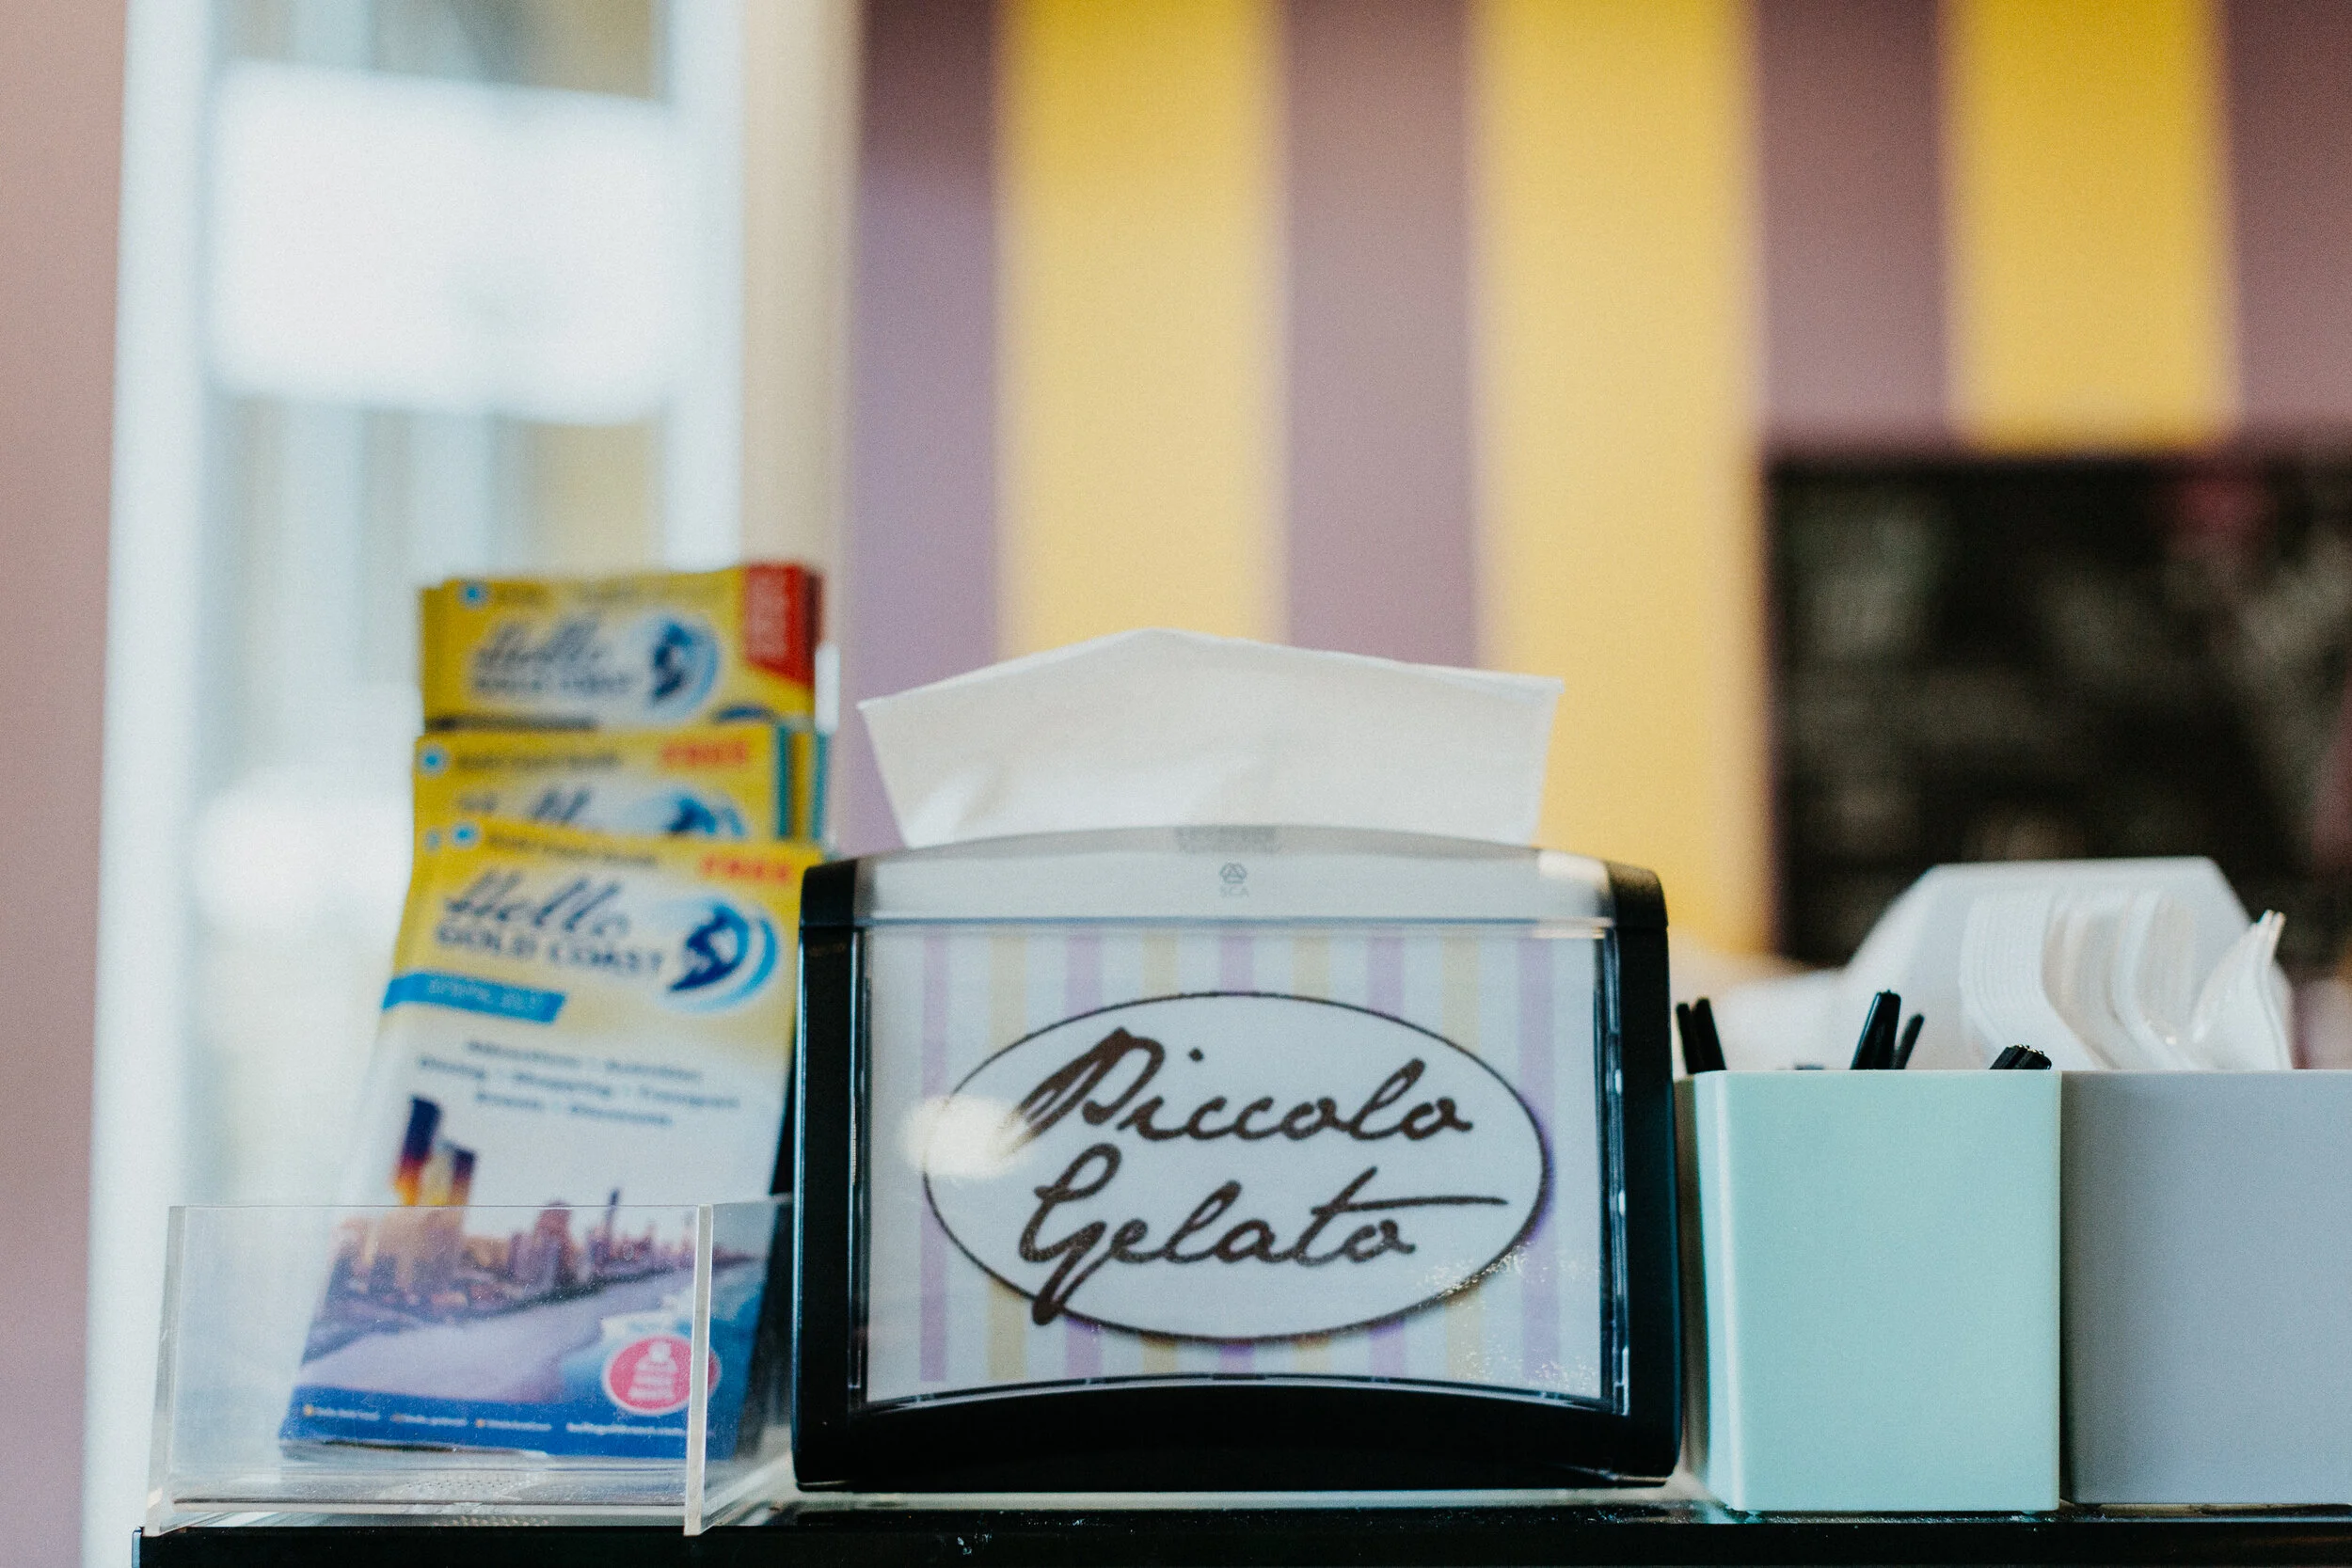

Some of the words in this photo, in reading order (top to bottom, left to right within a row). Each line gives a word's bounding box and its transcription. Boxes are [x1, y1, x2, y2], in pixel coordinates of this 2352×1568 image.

[436, 919, 538, 960] GOLD
[548, 942, 666, 976] COAST
[1001, 1027, 1473, 1154] Piccolo
[1019, 1142, 1509, 1326] Gelato
